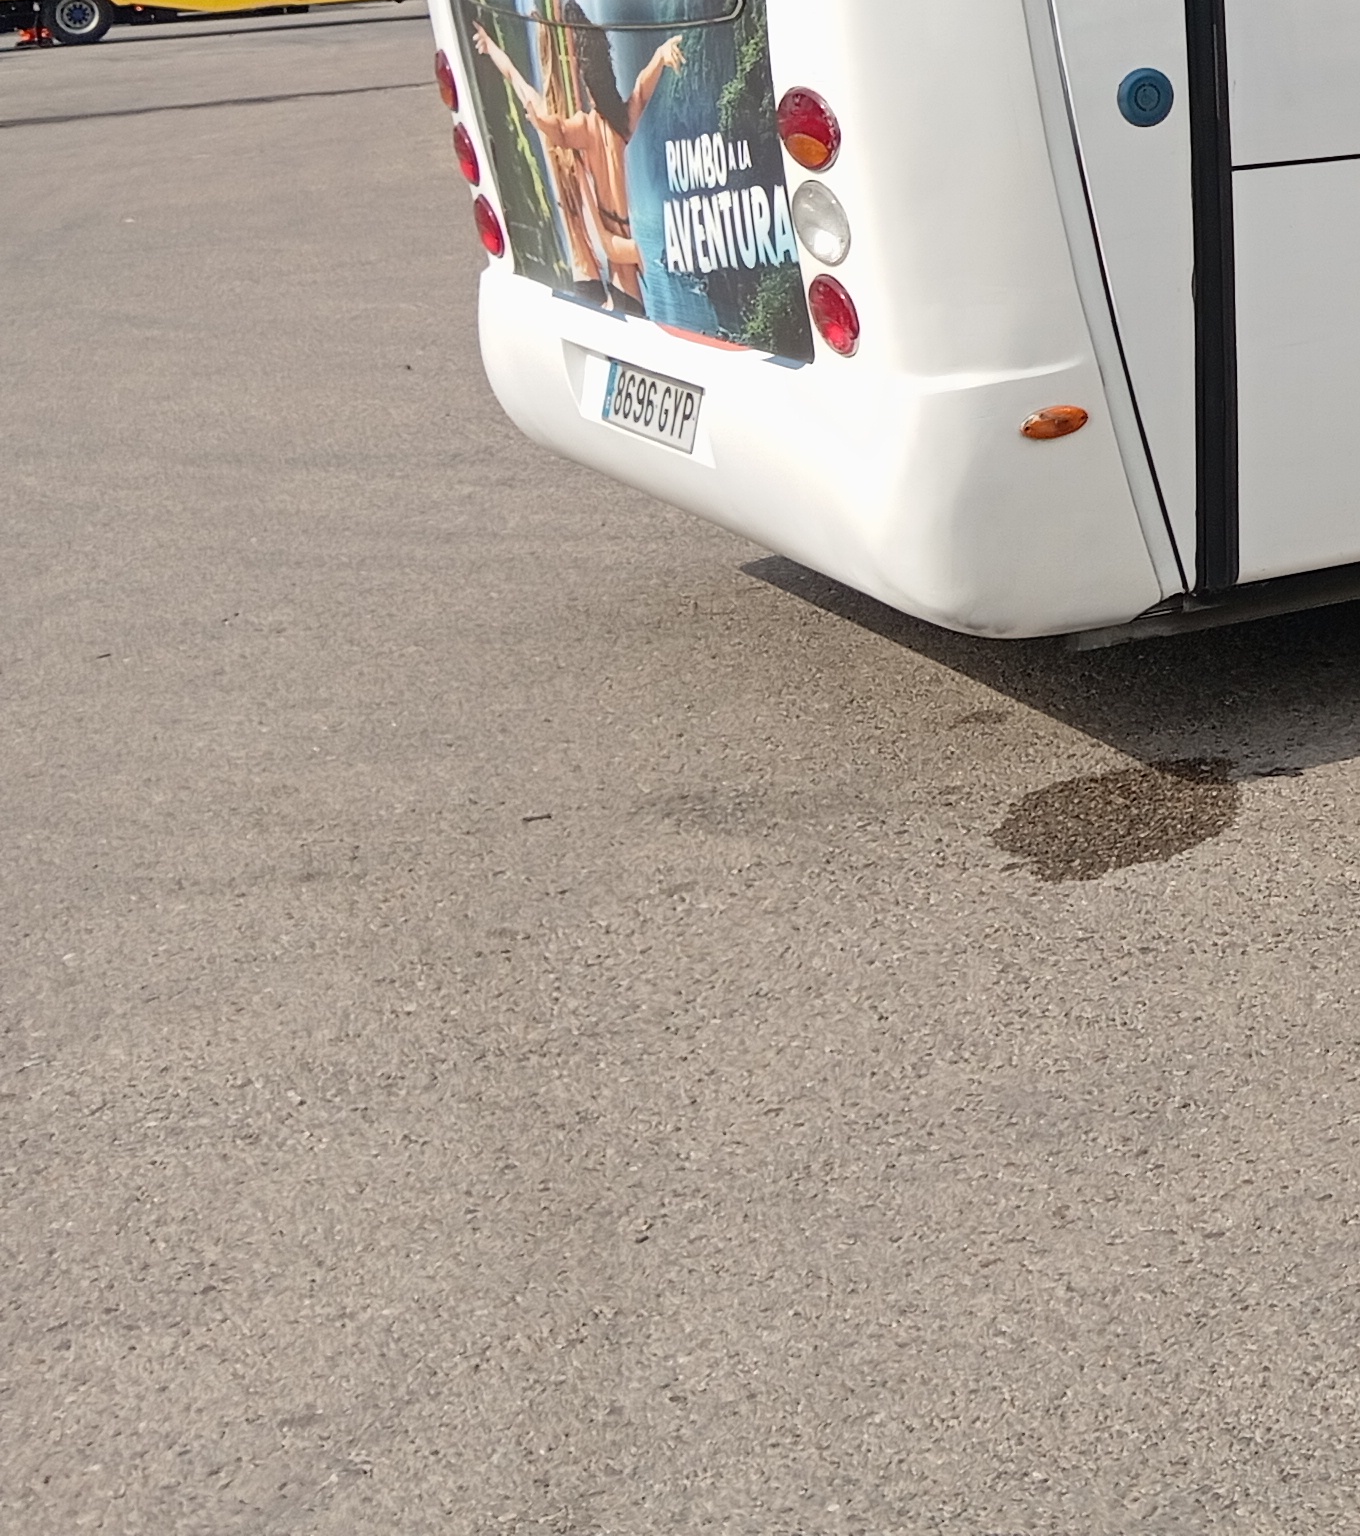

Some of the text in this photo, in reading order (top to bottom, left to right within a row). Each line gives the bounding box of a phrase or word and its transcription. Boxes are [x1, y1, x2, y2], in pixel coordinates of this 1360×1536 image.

[665, 132, 752, 194] RUMBO A LA
[663, 184, 800, 274] AVENTURA
[613, 370, 695, 440] 8696 GYP
